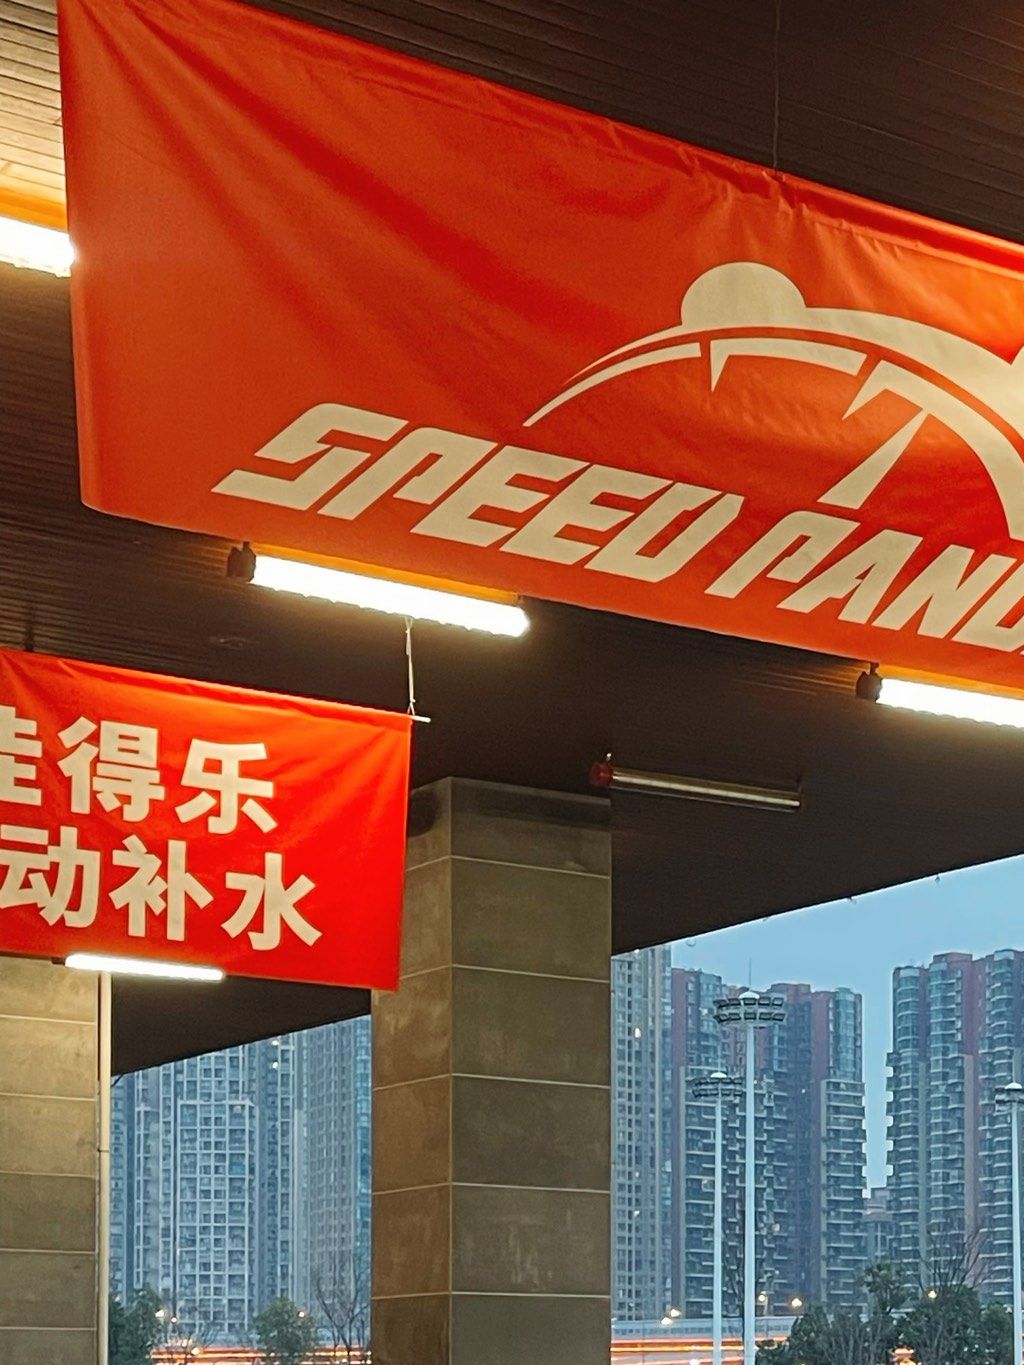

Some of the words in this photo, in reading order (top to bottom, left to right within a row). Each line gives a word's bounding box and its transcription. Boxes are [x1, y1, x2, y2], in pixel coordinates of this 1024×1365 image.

[210, 402, 745, 583] SPEED
[0, 825, 323, 951] 动补水
